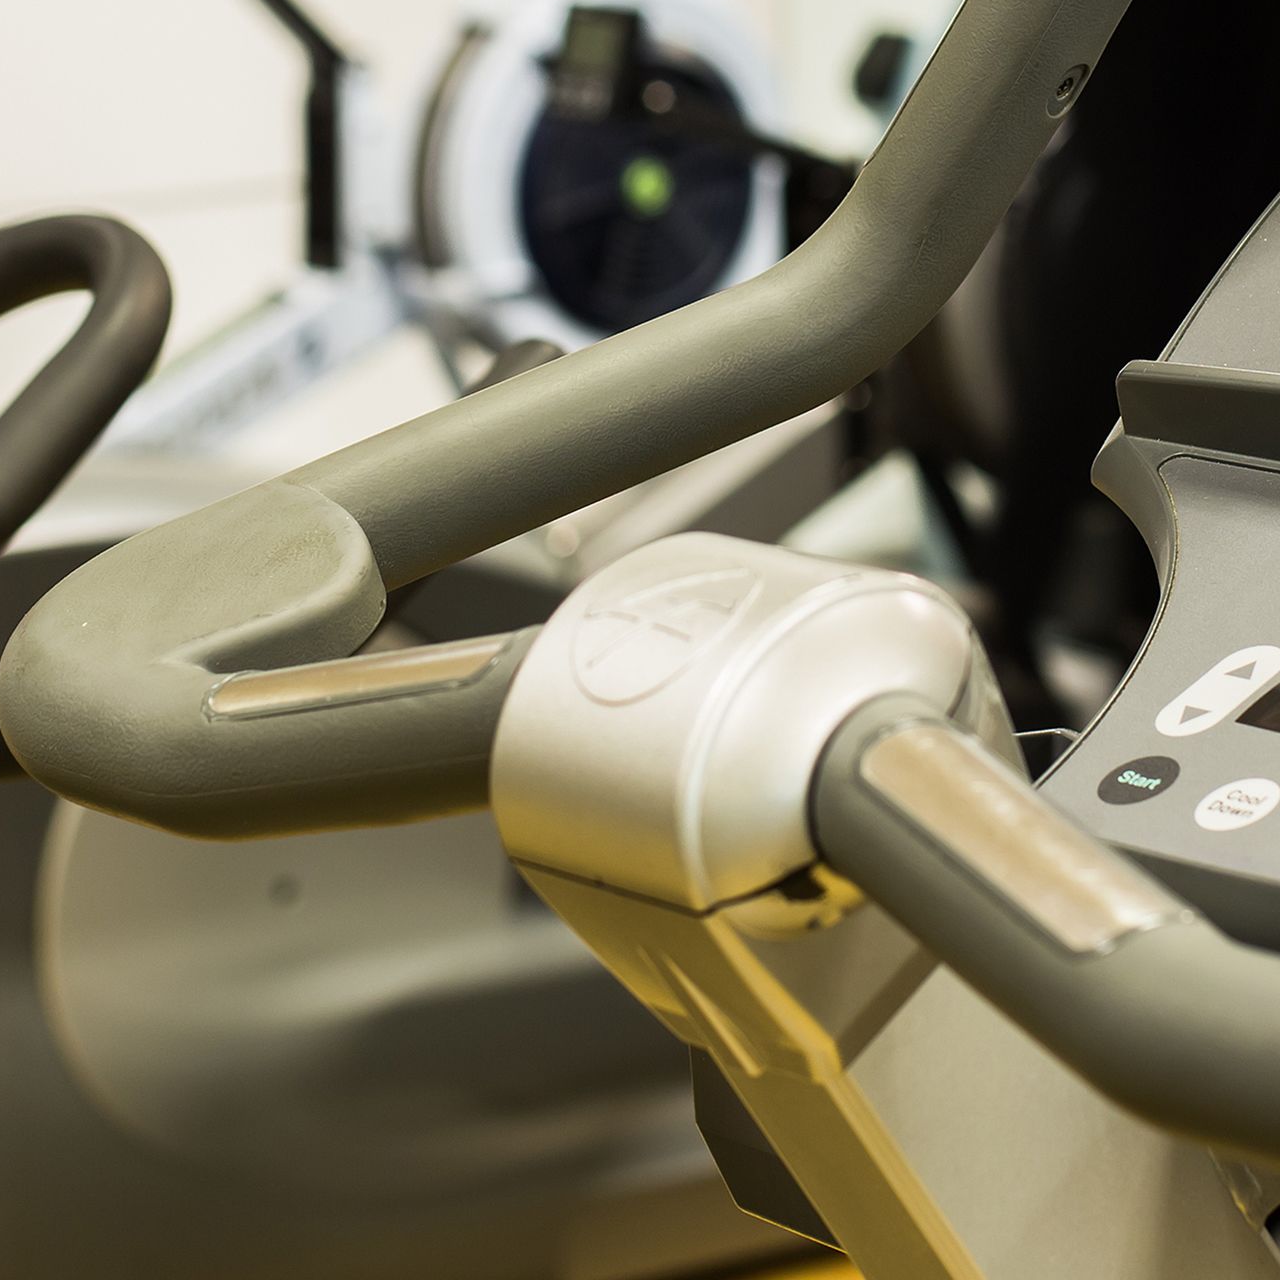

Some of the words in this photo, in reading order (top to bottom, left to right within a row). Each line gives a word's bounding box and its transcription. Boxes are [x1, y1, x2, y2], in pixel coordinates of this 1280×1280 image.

[1117, 770, 1162, 791] Start
[1226, 789, 1265, 806] Cool
[1207, 800, 1255, 818] Down
